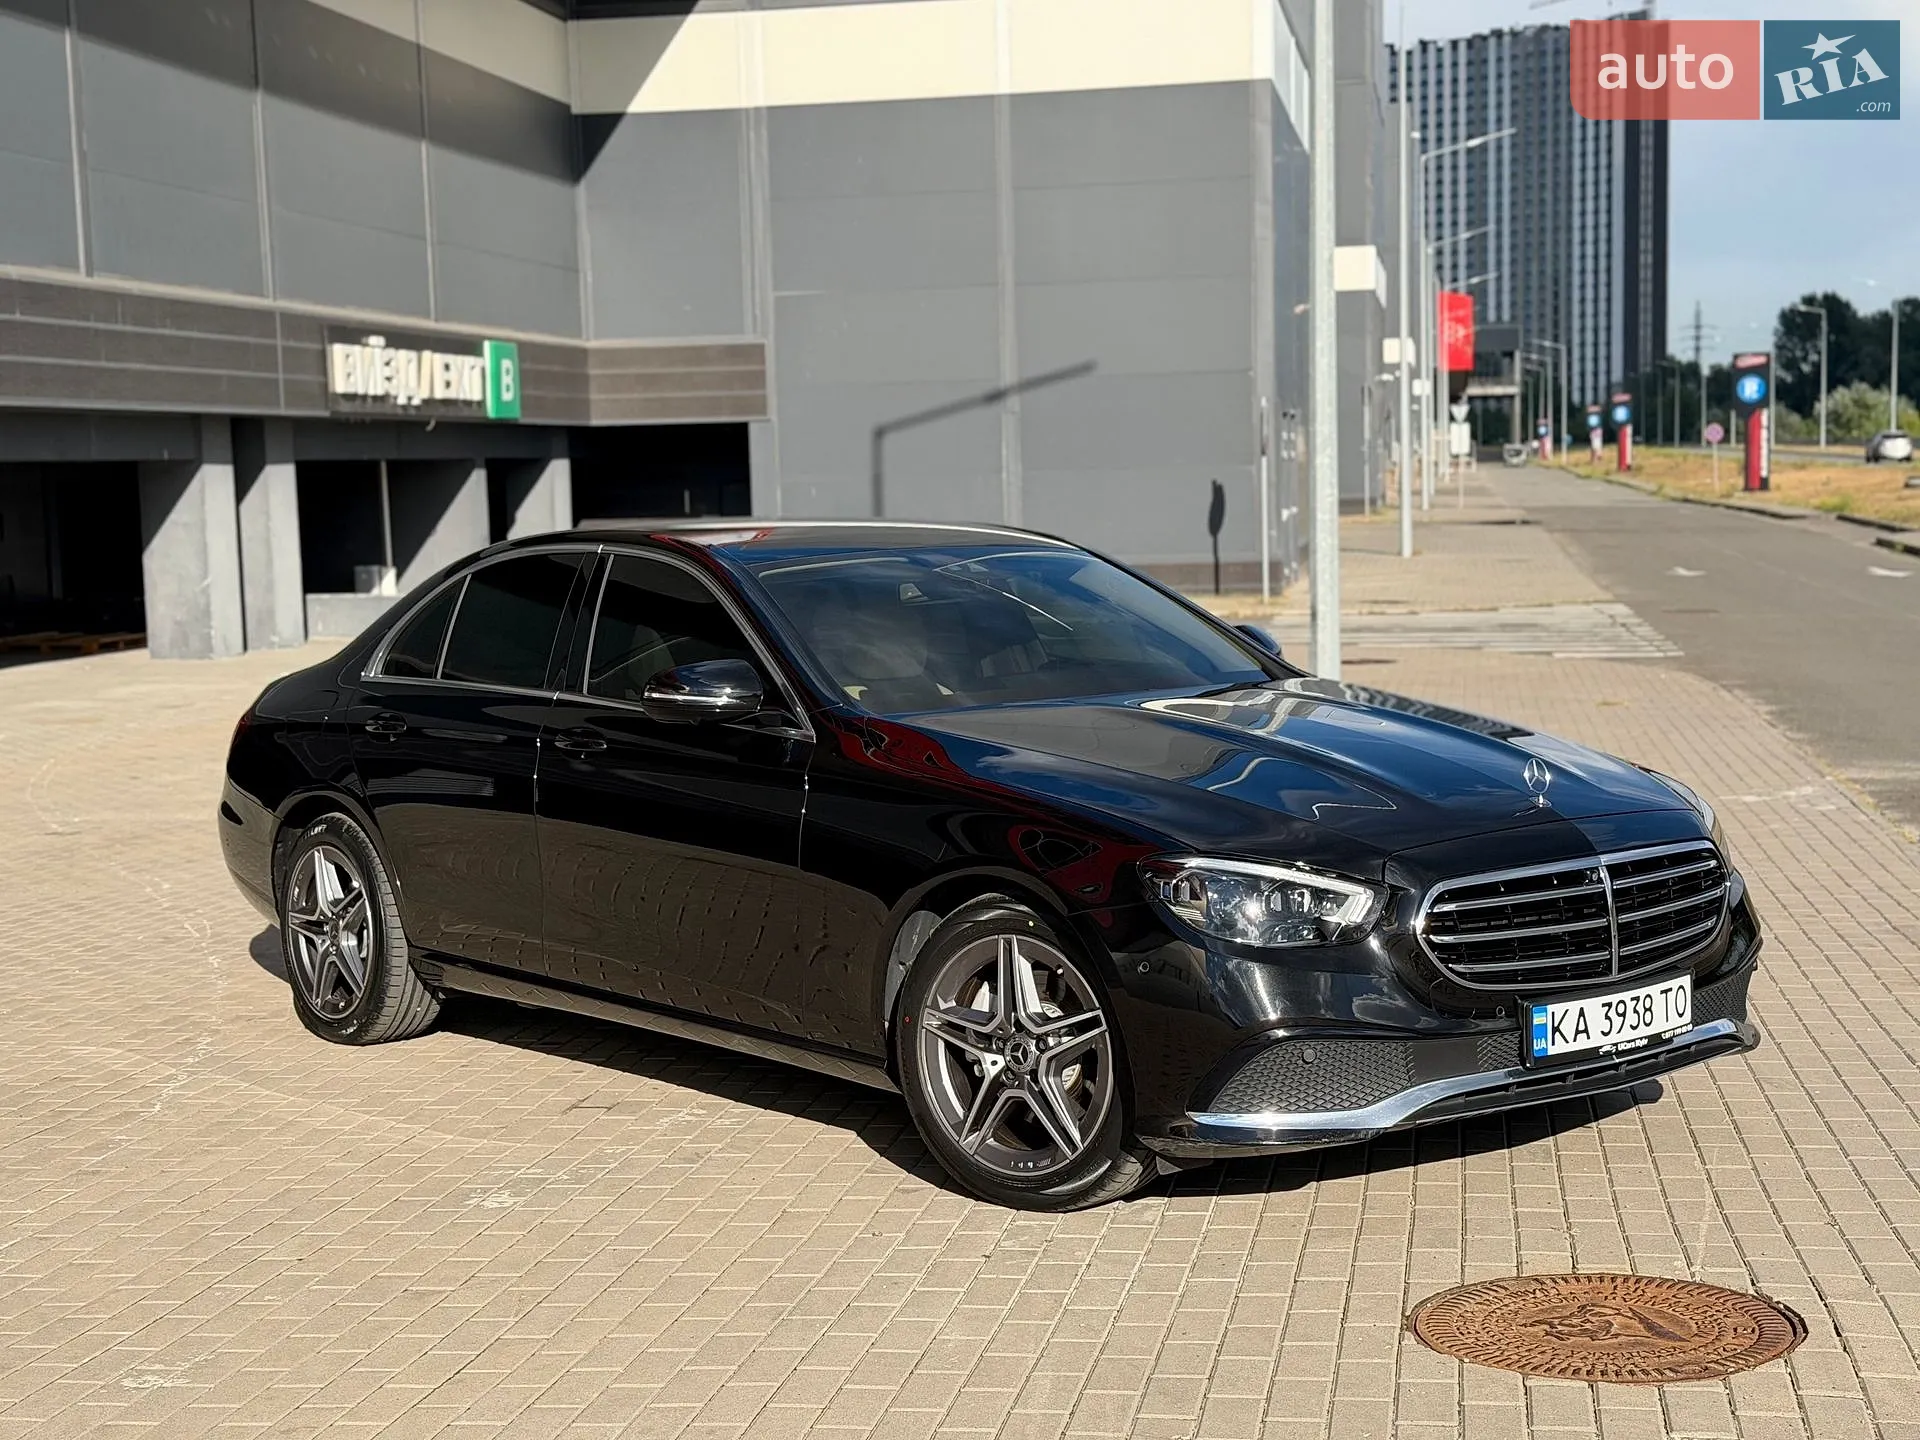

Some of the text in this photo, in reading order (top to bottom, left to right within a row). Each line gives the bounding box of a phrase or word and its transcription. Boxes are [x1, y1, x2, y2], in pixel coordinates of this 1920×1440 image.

[1551, 984, 1687, 1047] KA 3938 TO
[1534, 1037, 1547, 1050] UA
